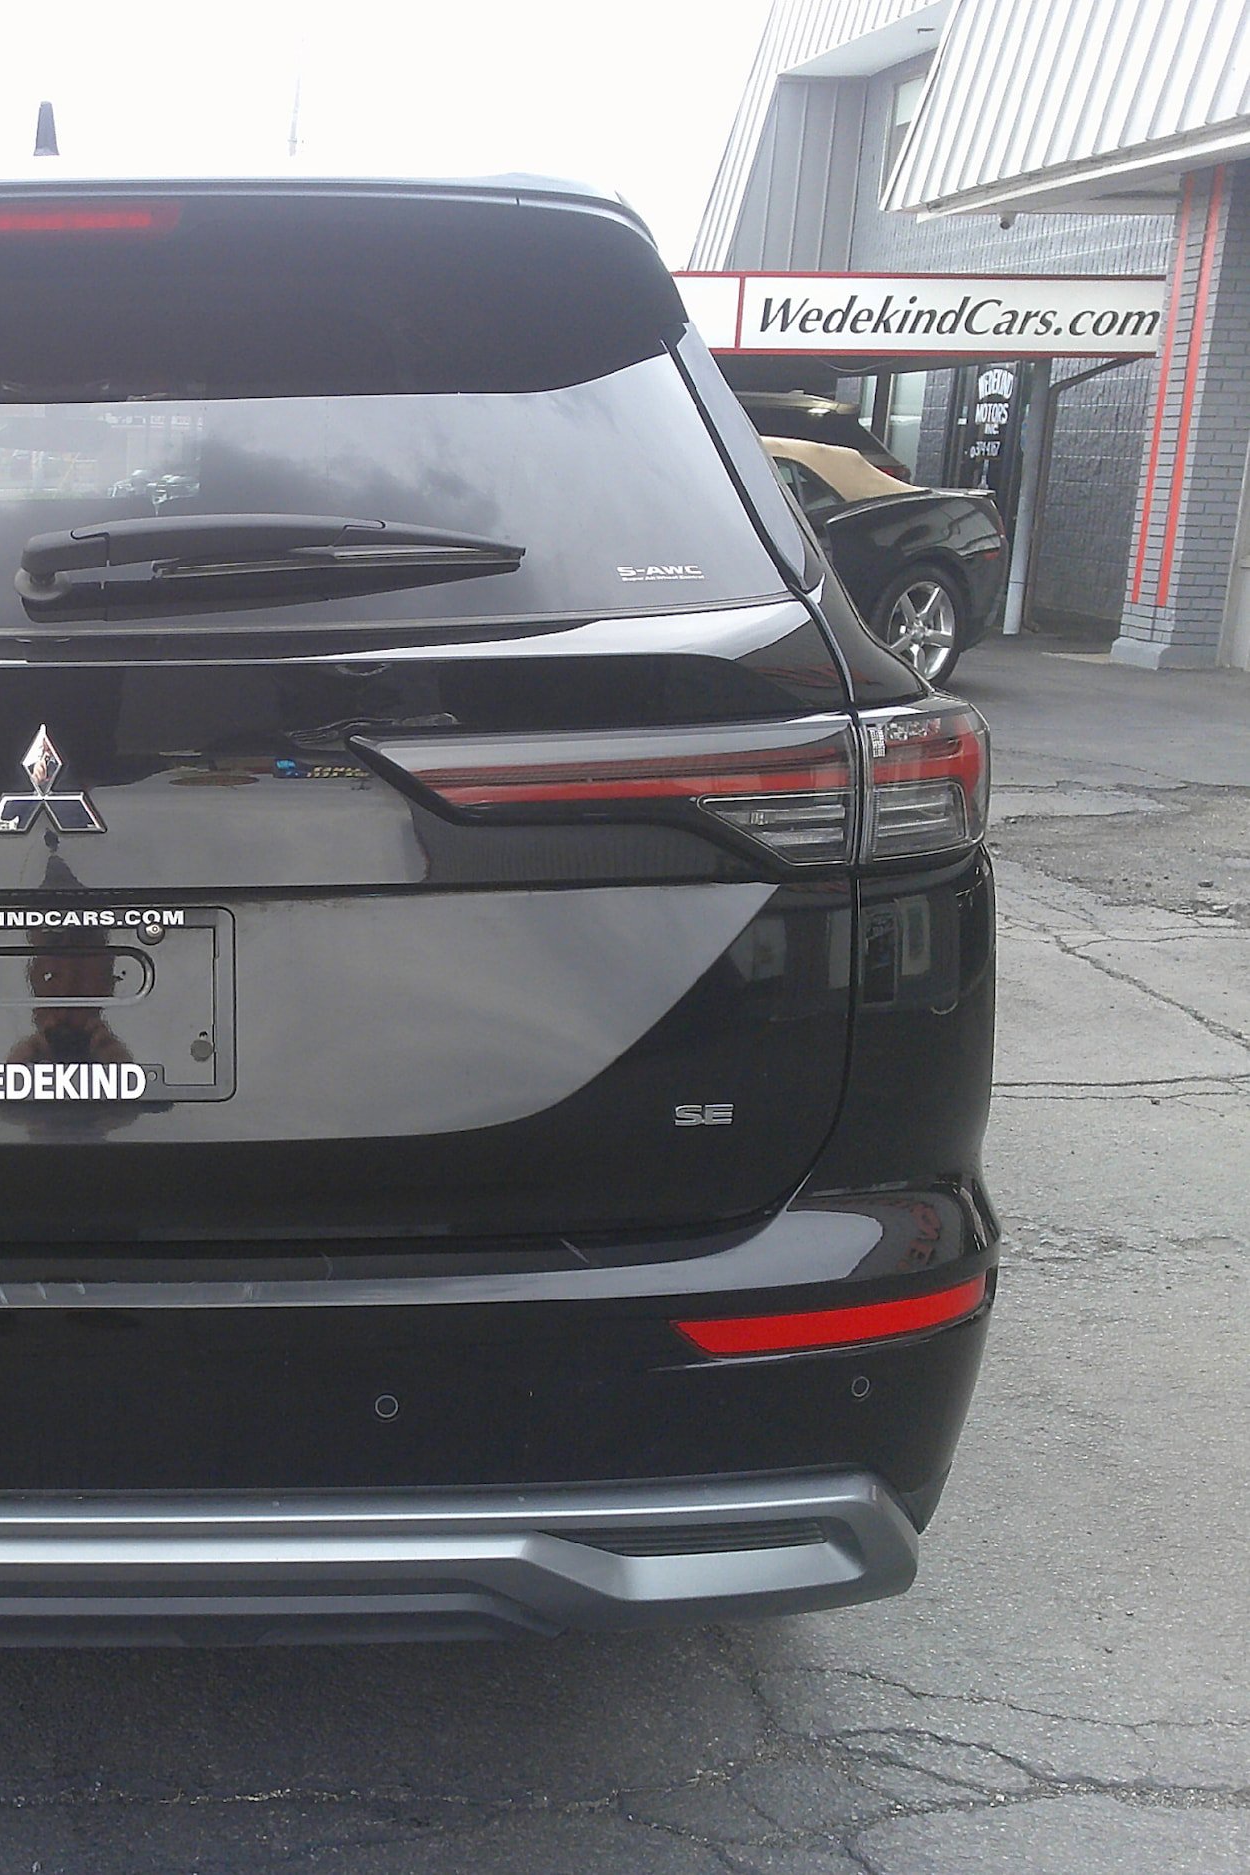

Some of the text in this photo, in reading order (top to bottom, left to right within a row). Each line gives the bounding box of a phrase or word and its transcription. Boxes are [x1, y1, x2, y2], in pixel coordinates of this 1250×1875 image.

[759, 295, 1161, 337] WedekindCars.com
[978, 368, 1014, 400] WEDEKIND
[975, 403, 1009, 425] MOTORS
[617, 565, 702, 577] S-AWC
[674, 1103, 734, 1126] SE
